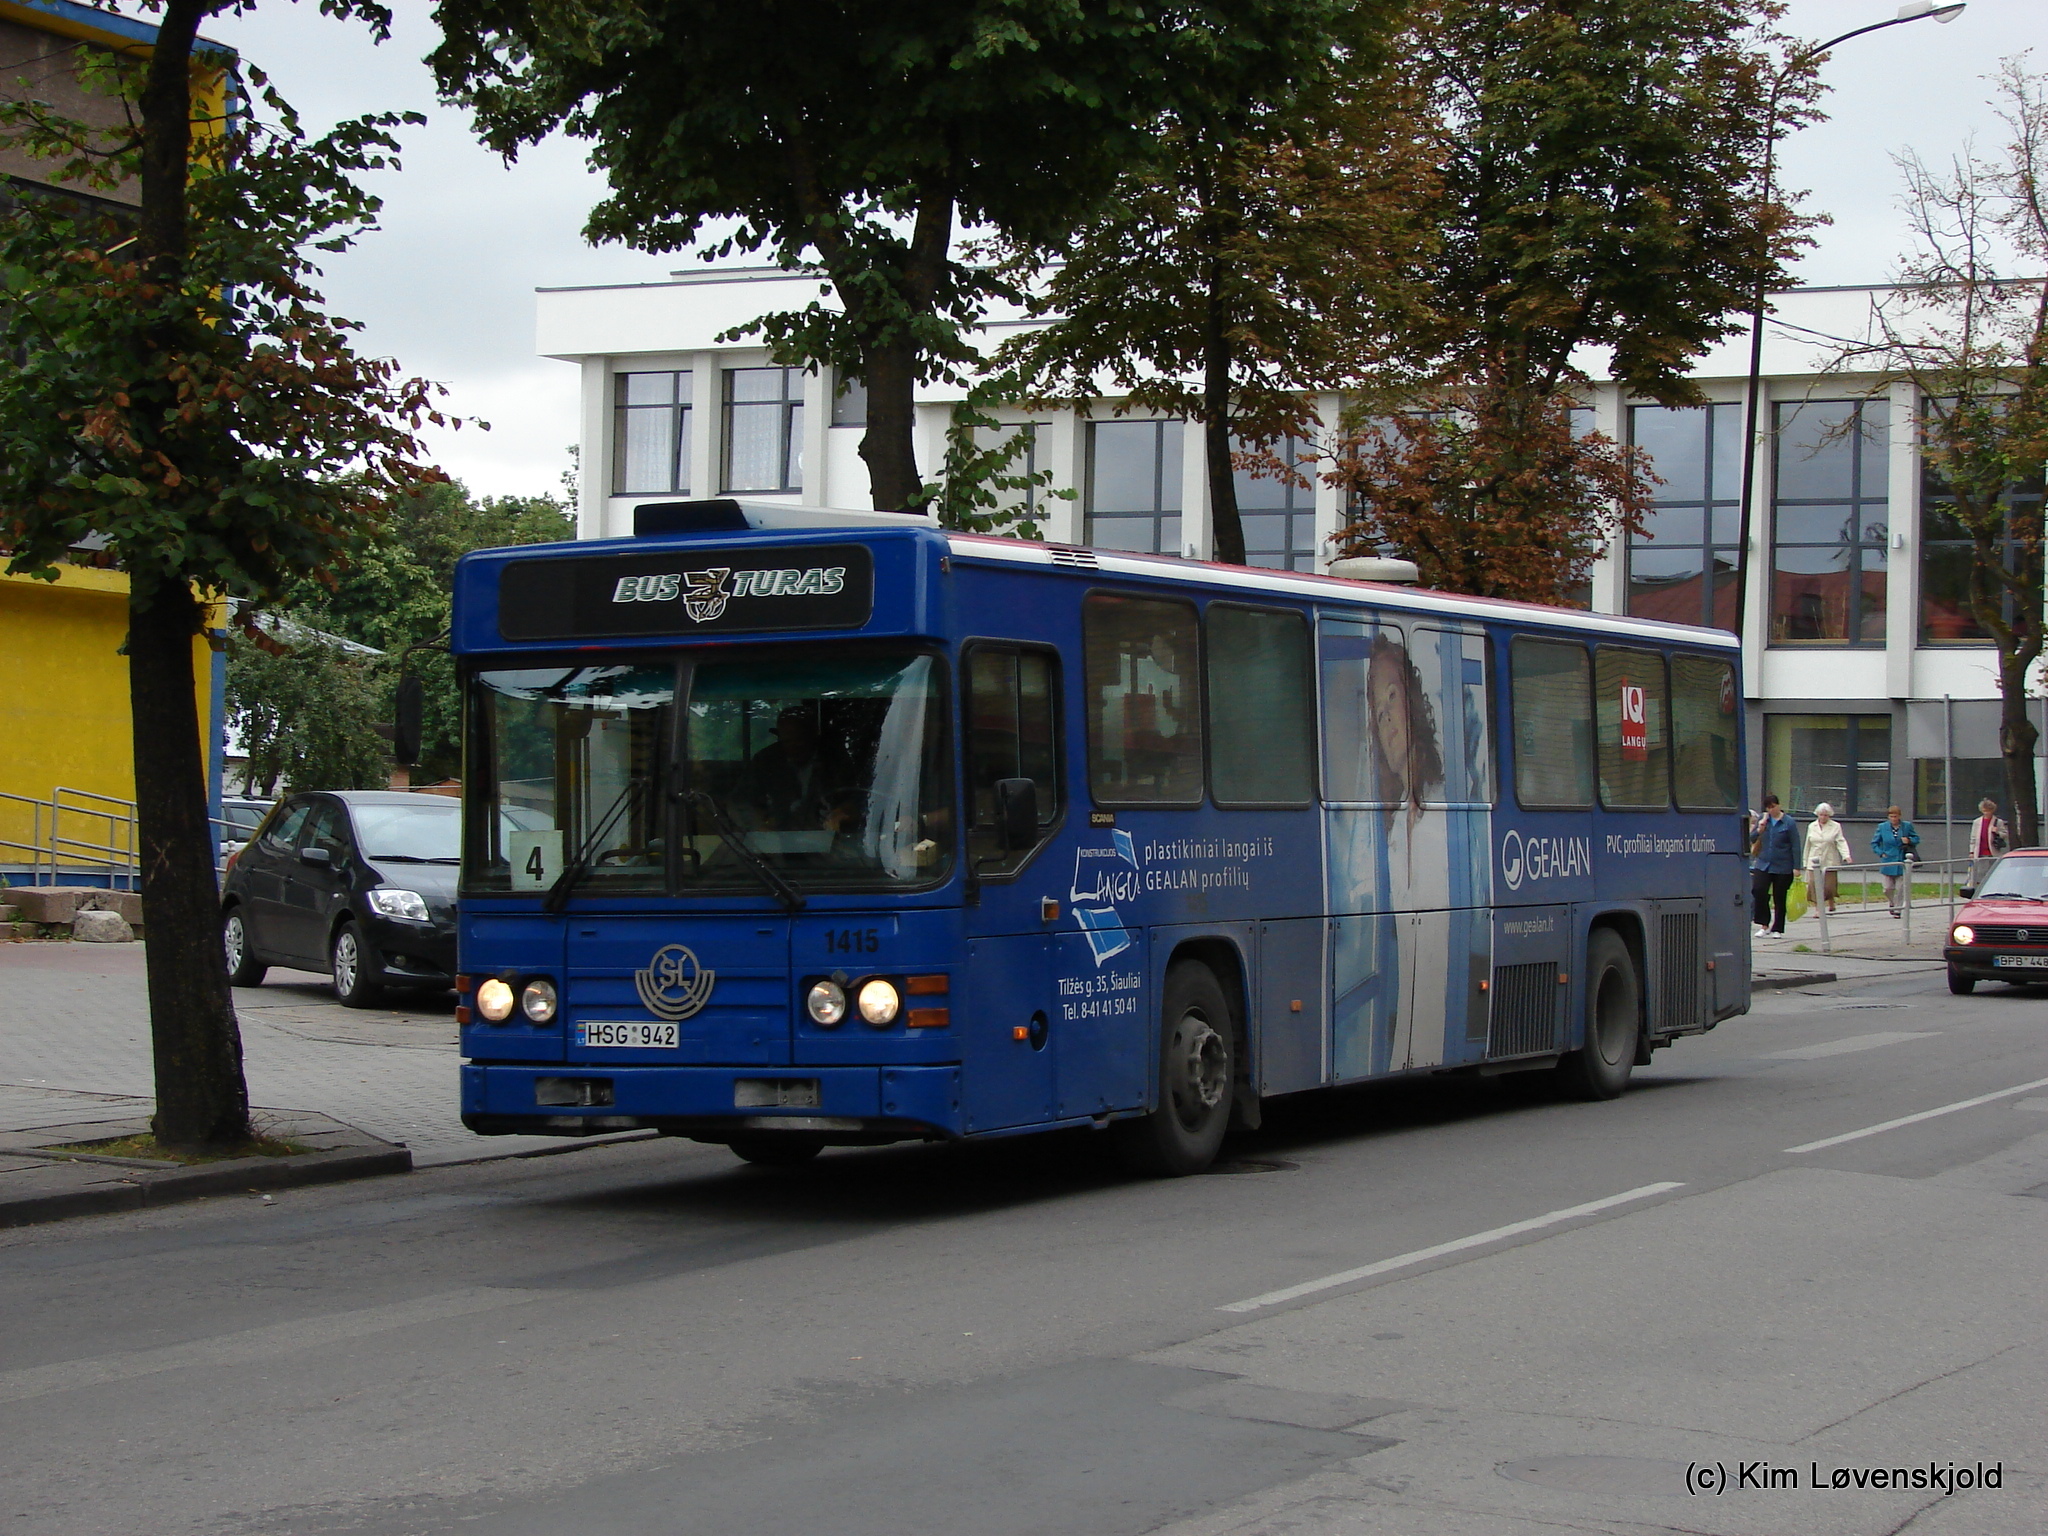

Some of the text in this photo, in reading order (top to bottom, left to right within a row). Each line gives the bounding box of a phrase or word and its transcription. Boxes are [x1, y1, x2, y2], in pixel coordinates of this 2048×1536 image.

[612, 567, 847, 603] BUS TURAS
[1621, 686, 1645, 724] IQ
[1091, 813, 1115, 823] SCANIA
[1145, 837, 1273, 866] plastikiniai langai iš
[1526, 837, 1591, 881] GEALAN
[1606, 833, 1716, 858] PVC profiliai langams ir durims
[525, 846, 544, 881] 4
[1145, 866, 1249, 893] GEALAN profilių
[1503, 915, 1554, 938] www.gealan.lt
[825, 928, 880, 954] 1415
[659, 958, 691, 988] SL
[1086, 980, 1095, 998] g.
[1096, 975, 1109, 994] 35,
[1111, 970, 1141, 991] Šiauliai
[1062, 997, 1137, 1021] Tel. 8-41 41 50 41
[588, 1024, 628, 1045] HSG
[641, 1025, 675, 1046] 942
